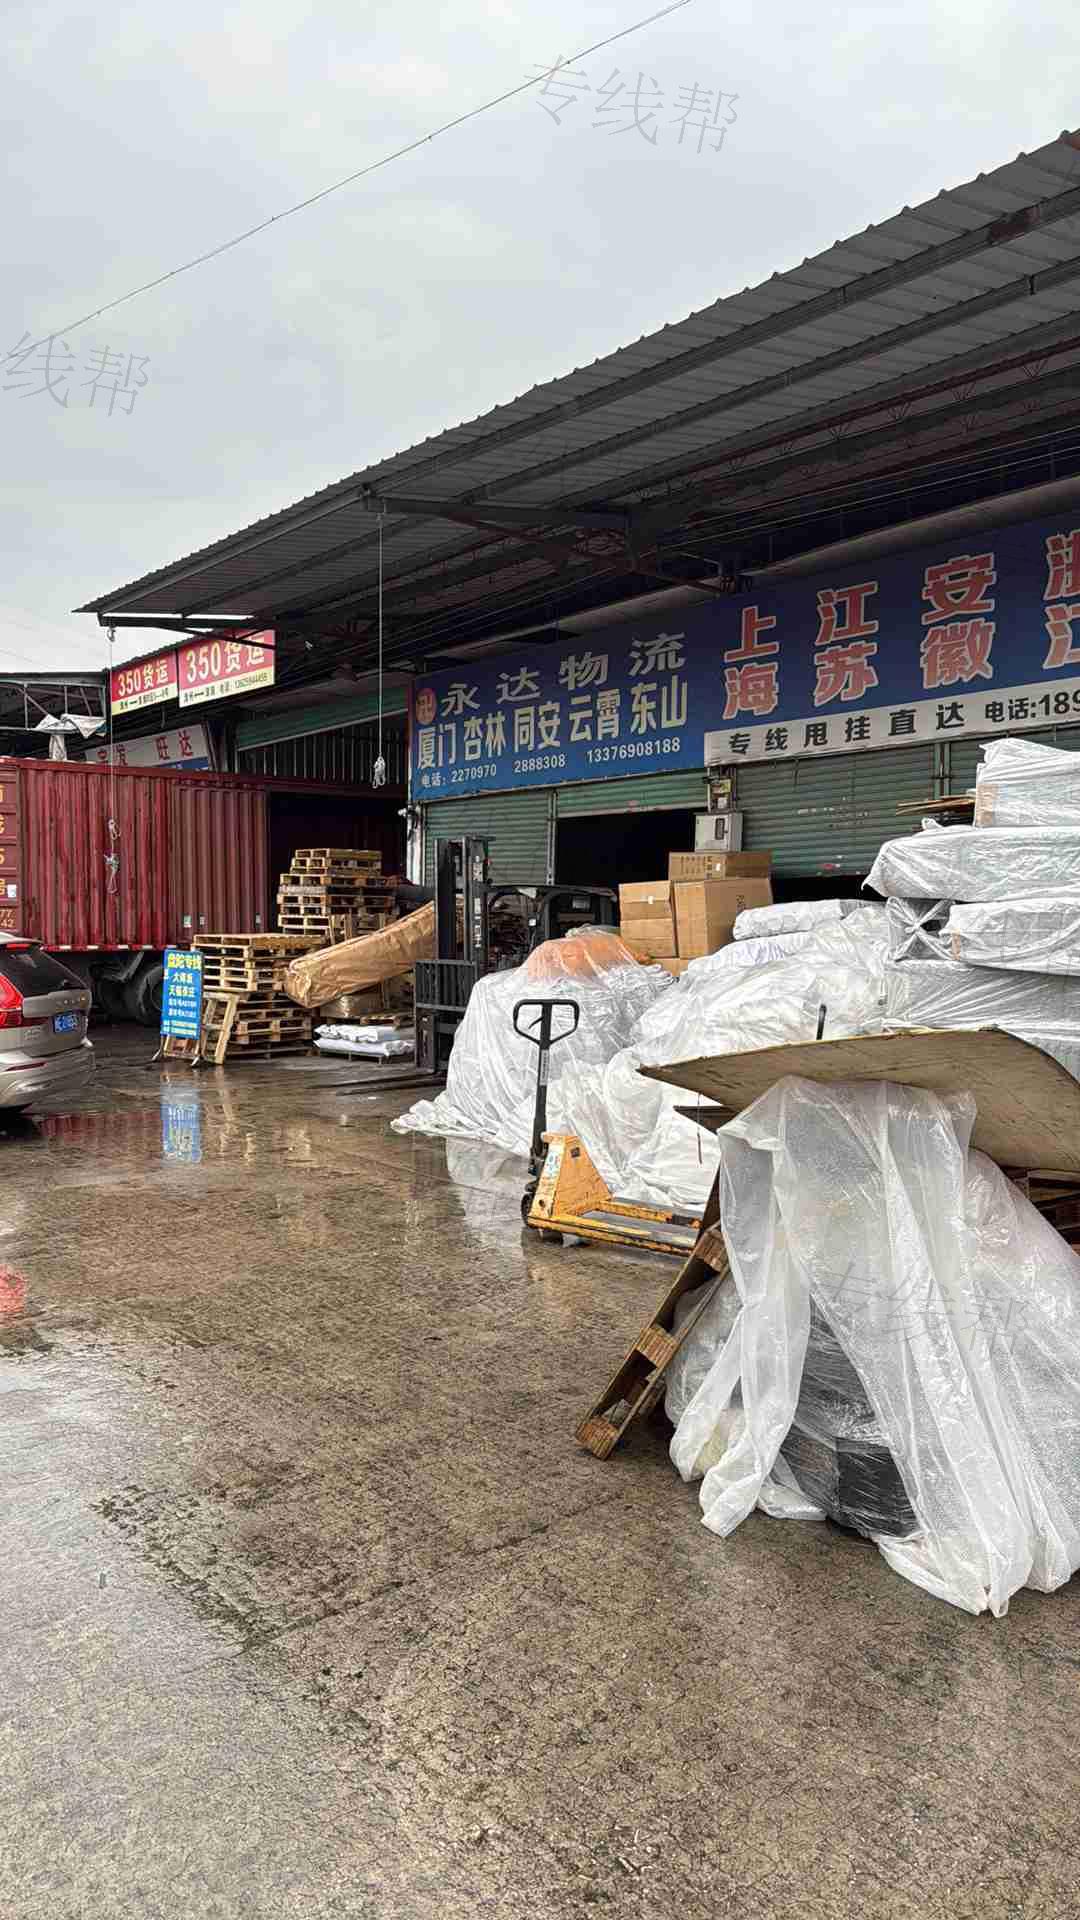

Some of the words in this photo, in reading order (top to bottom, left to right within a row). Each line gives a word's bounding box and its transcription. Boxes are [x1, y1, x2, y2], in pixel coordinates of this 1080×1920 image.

[118, 659, 169, 697] 350货运
[186, 636, 265, 683] 350货运
[441, 632, 686, 717] 永达物流
[728, 702, 965, 756] 专线甩挂直达
[514, 753, 566, 774] 2888308
[587, 737, 681, 764] 13376908188
